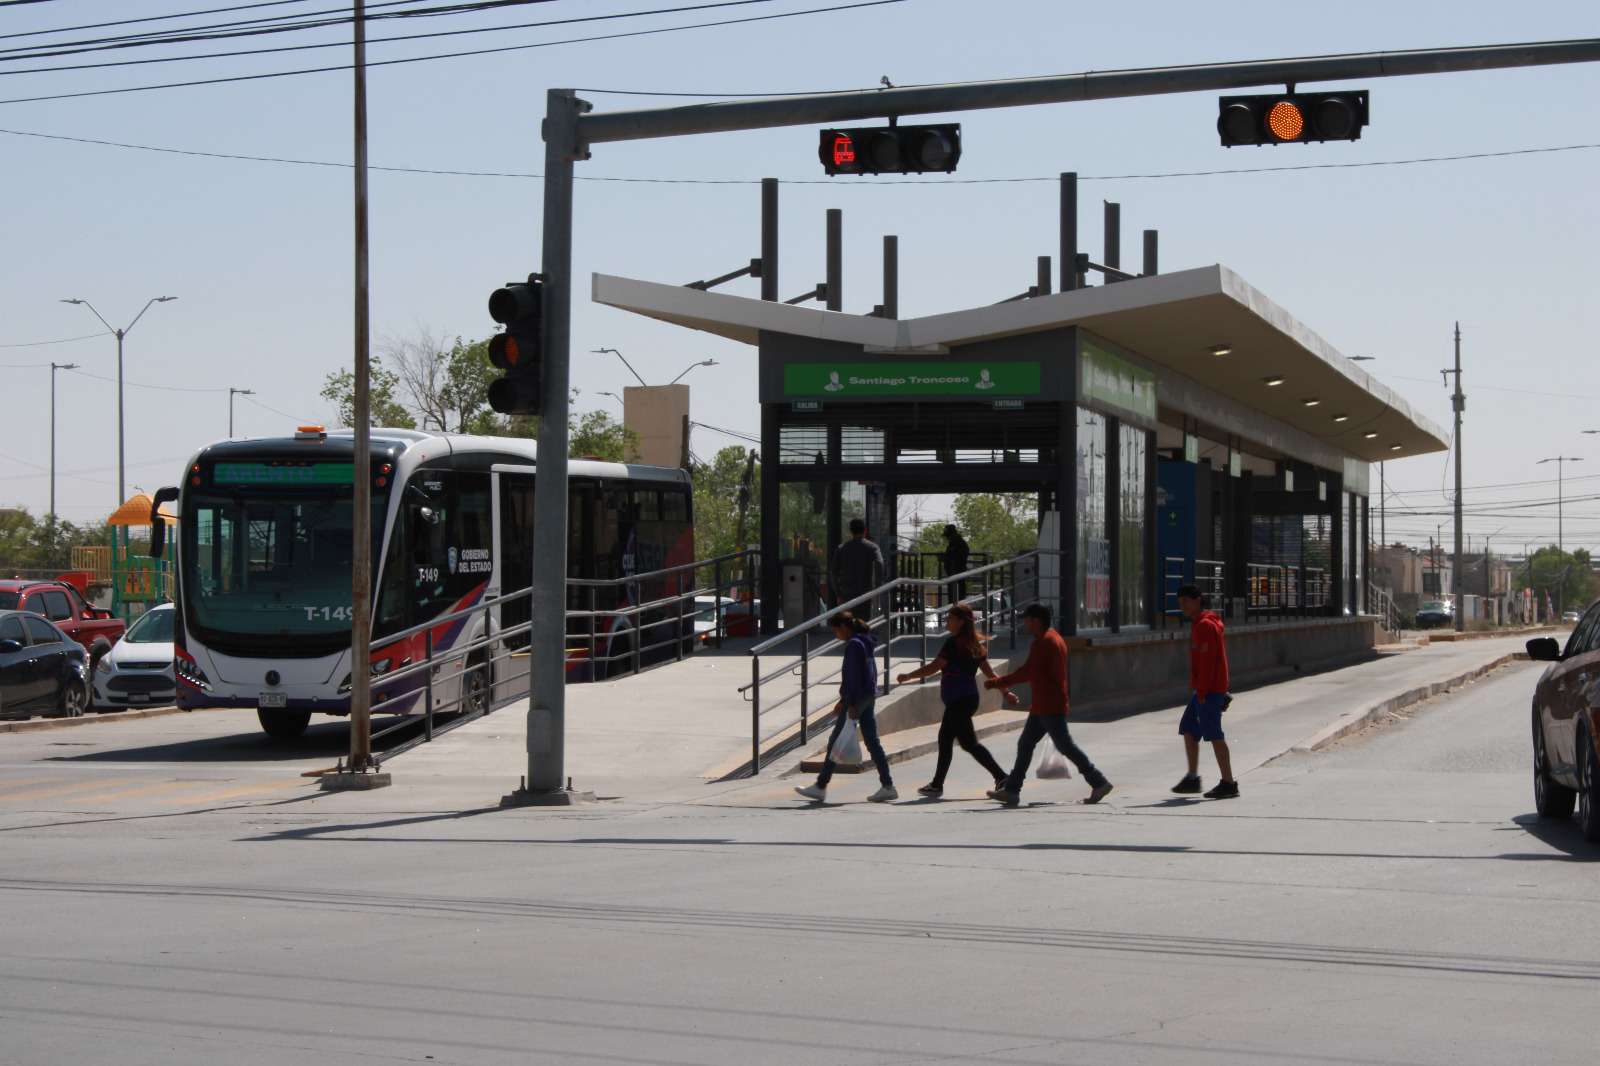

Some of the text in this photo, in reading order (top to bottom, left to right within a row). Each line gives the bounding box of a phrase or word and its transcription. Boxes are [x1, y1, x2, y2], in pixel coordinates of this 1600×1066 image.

[848, 375, 970, 386] Santiago Troncoso
[461, 548, 489, 561] GOBIERNO
[458, 561, 492, 573] DEL ESTADO
[418, 567, 439, 582] T-149
